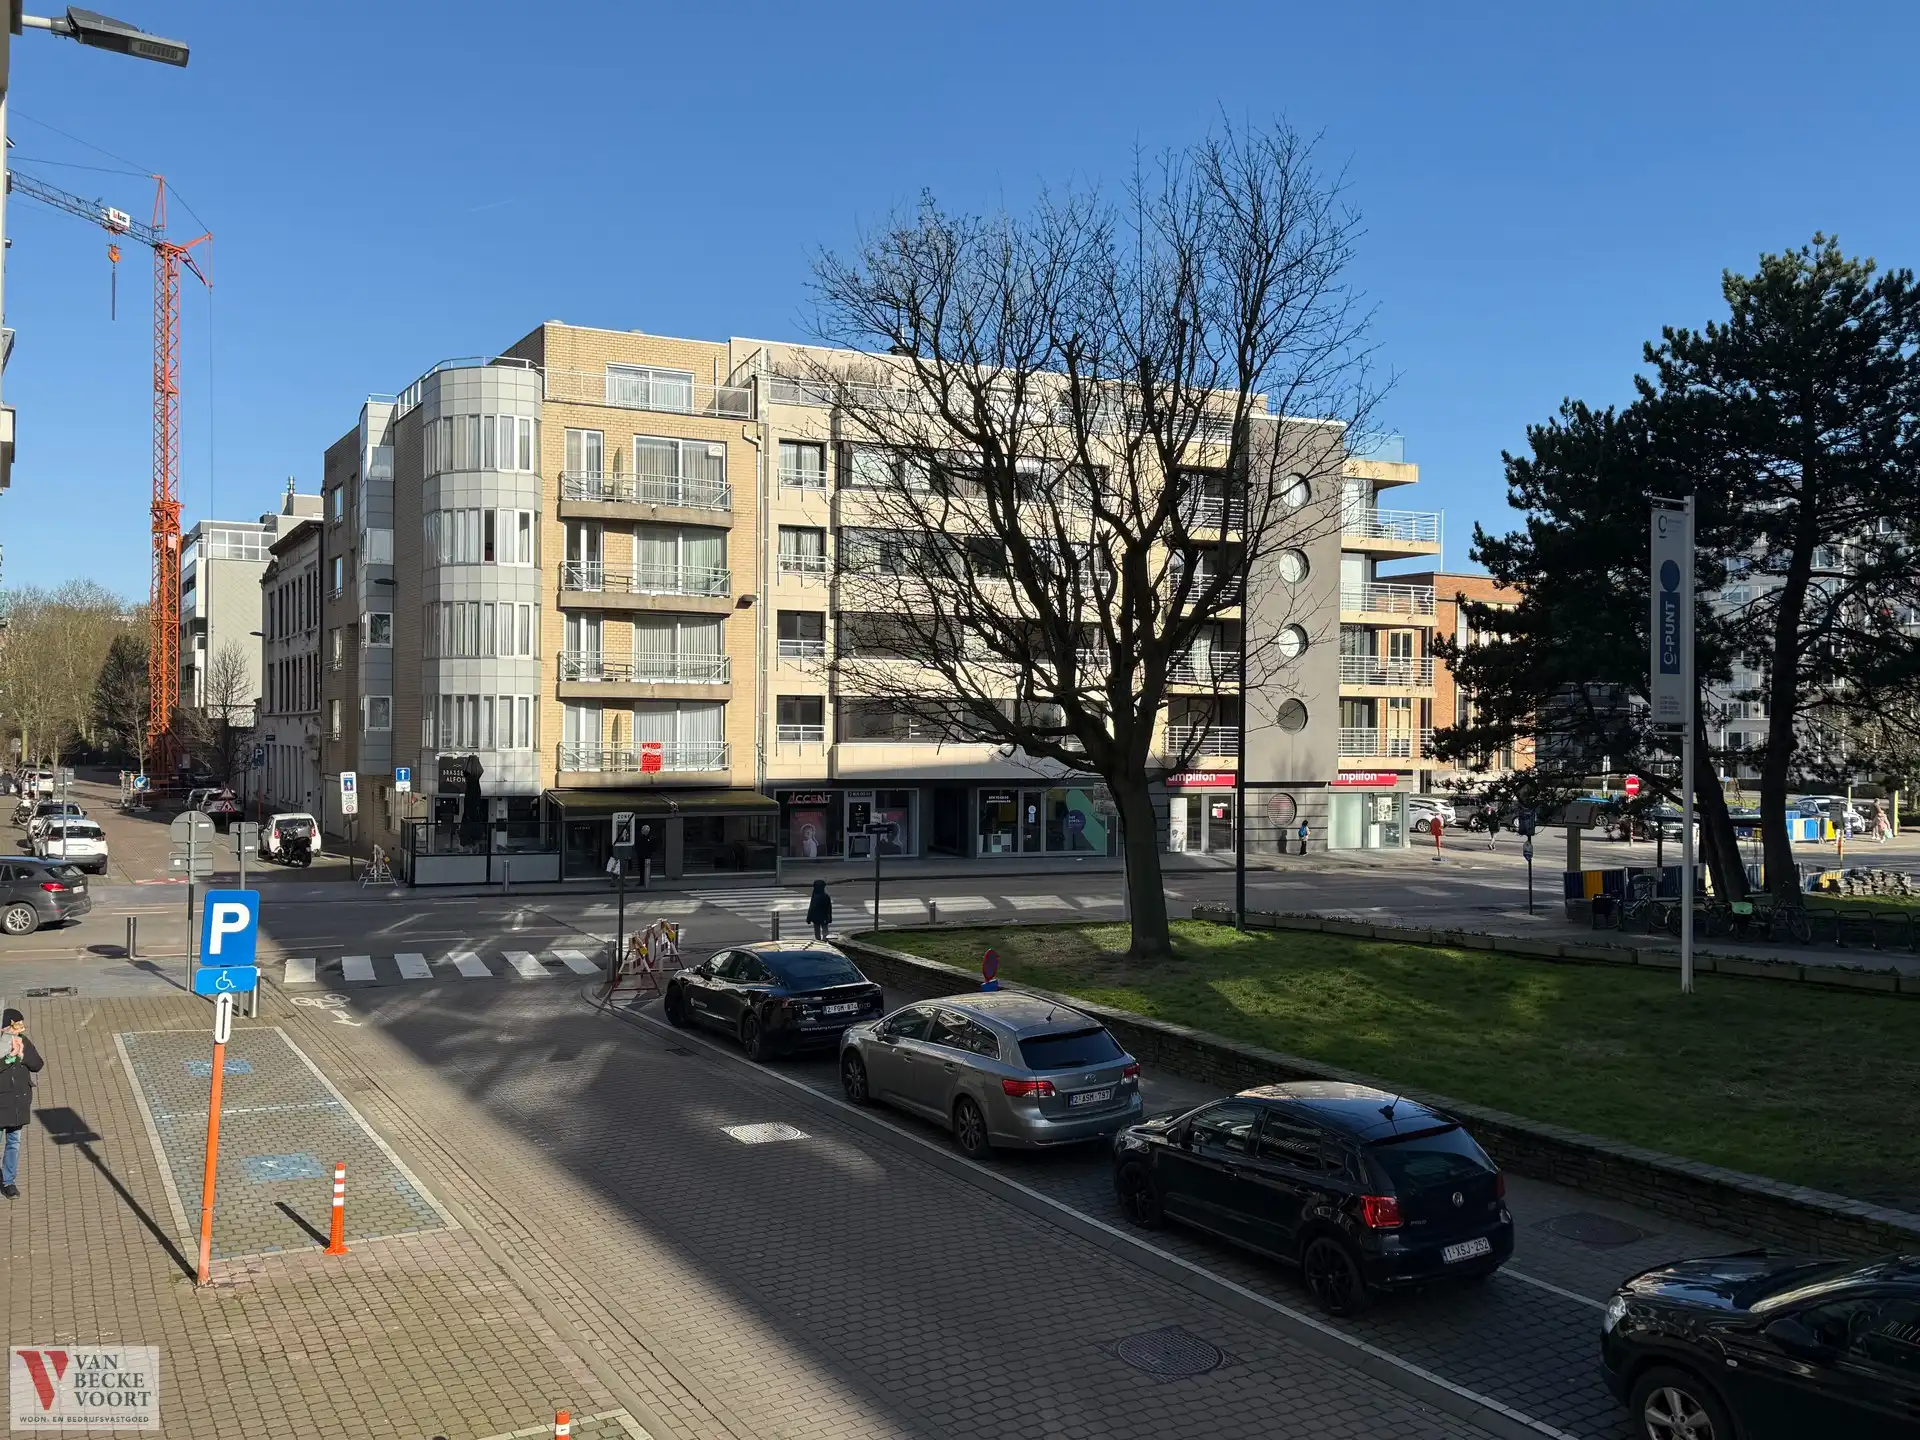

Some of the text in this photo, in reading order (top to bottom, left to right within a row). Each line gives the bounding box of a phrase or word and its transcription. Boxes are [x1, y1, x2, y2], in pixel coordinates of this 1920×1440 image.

[442, 769, 464, 777] BRASSE
[1338, 771, 1377, 784] mplifon
[787, 792, 832, 804] ACCENT
[209, 903, 250, 955] P
[1446, 1238, 1489, 1259] 1-XSJ-252
